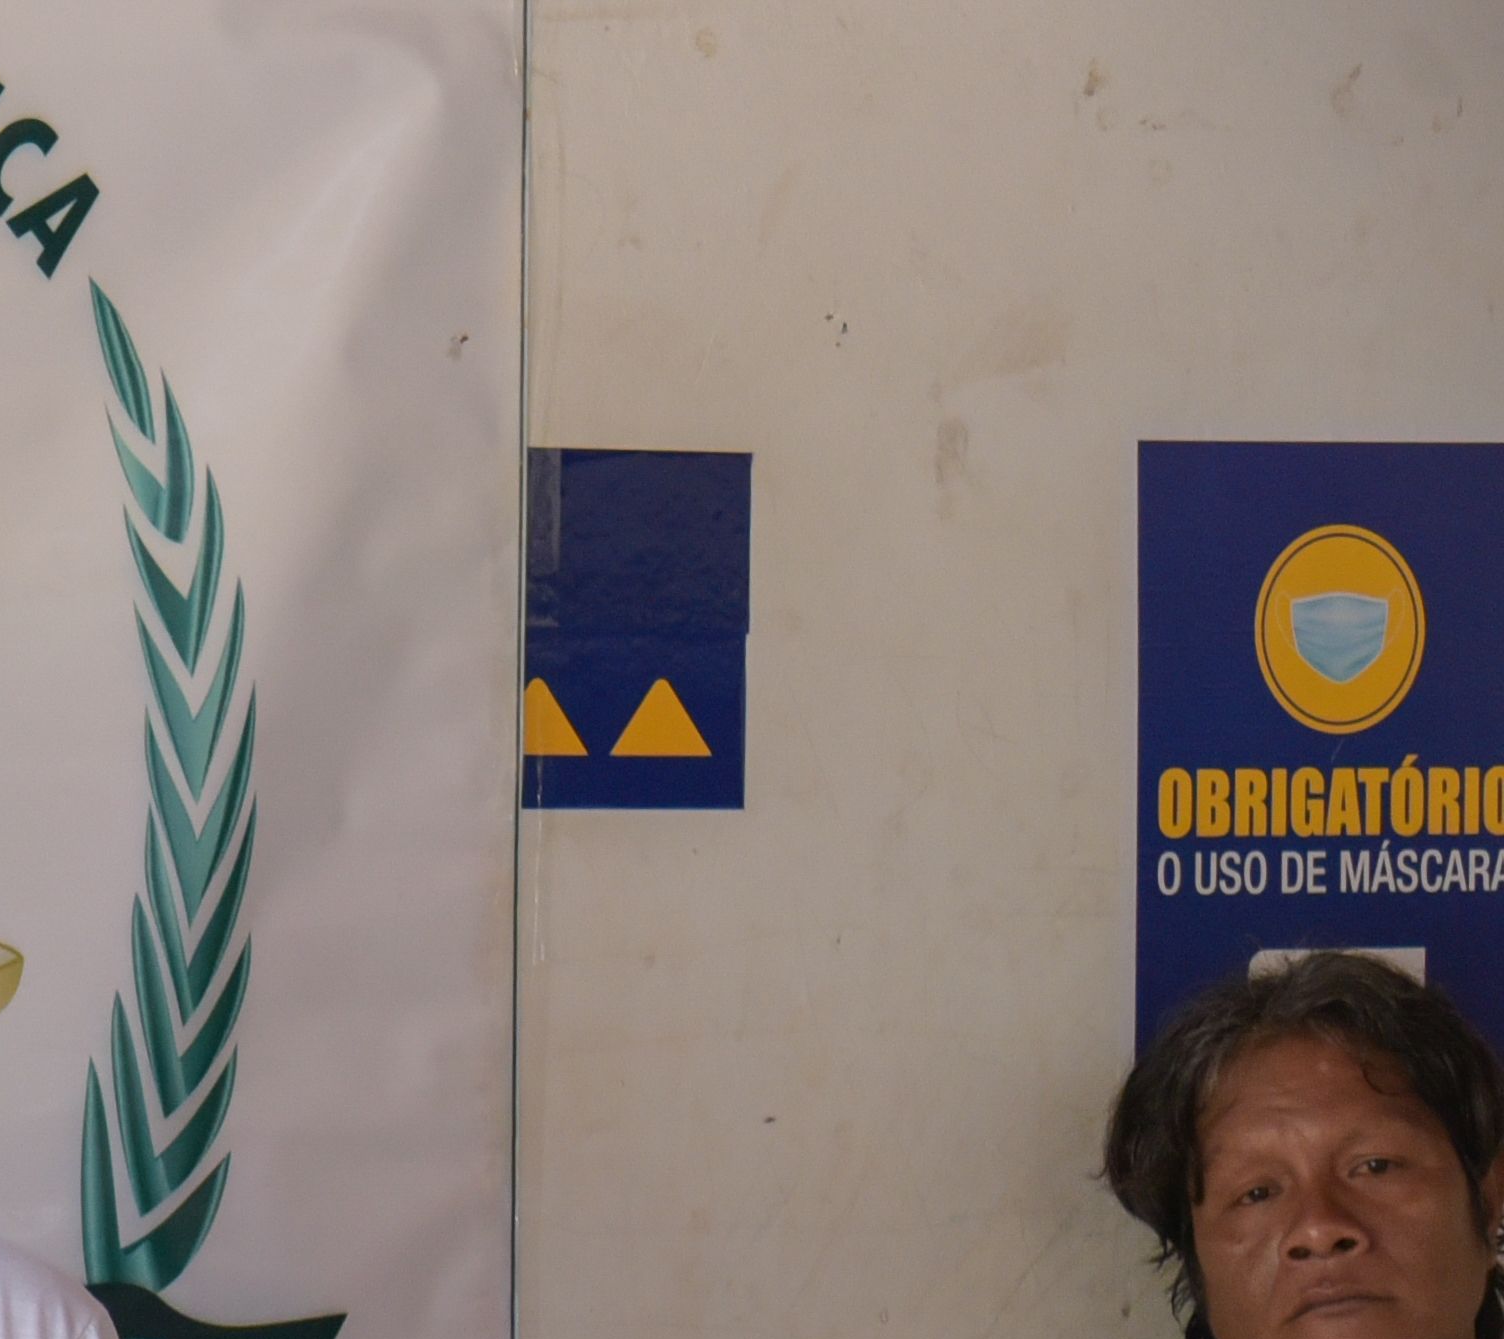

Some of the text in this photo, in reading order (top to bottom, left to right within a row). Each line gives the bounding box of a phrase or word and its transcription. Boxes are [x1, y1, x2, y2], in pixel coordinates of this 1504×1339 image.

[1157, 754, 1504, 839] OBRIGATÓRIO
[1157, 851, 1181, 895] O
[1195, 850, 1267, 894] USO
[1281, 850, 1326, 894] DE
